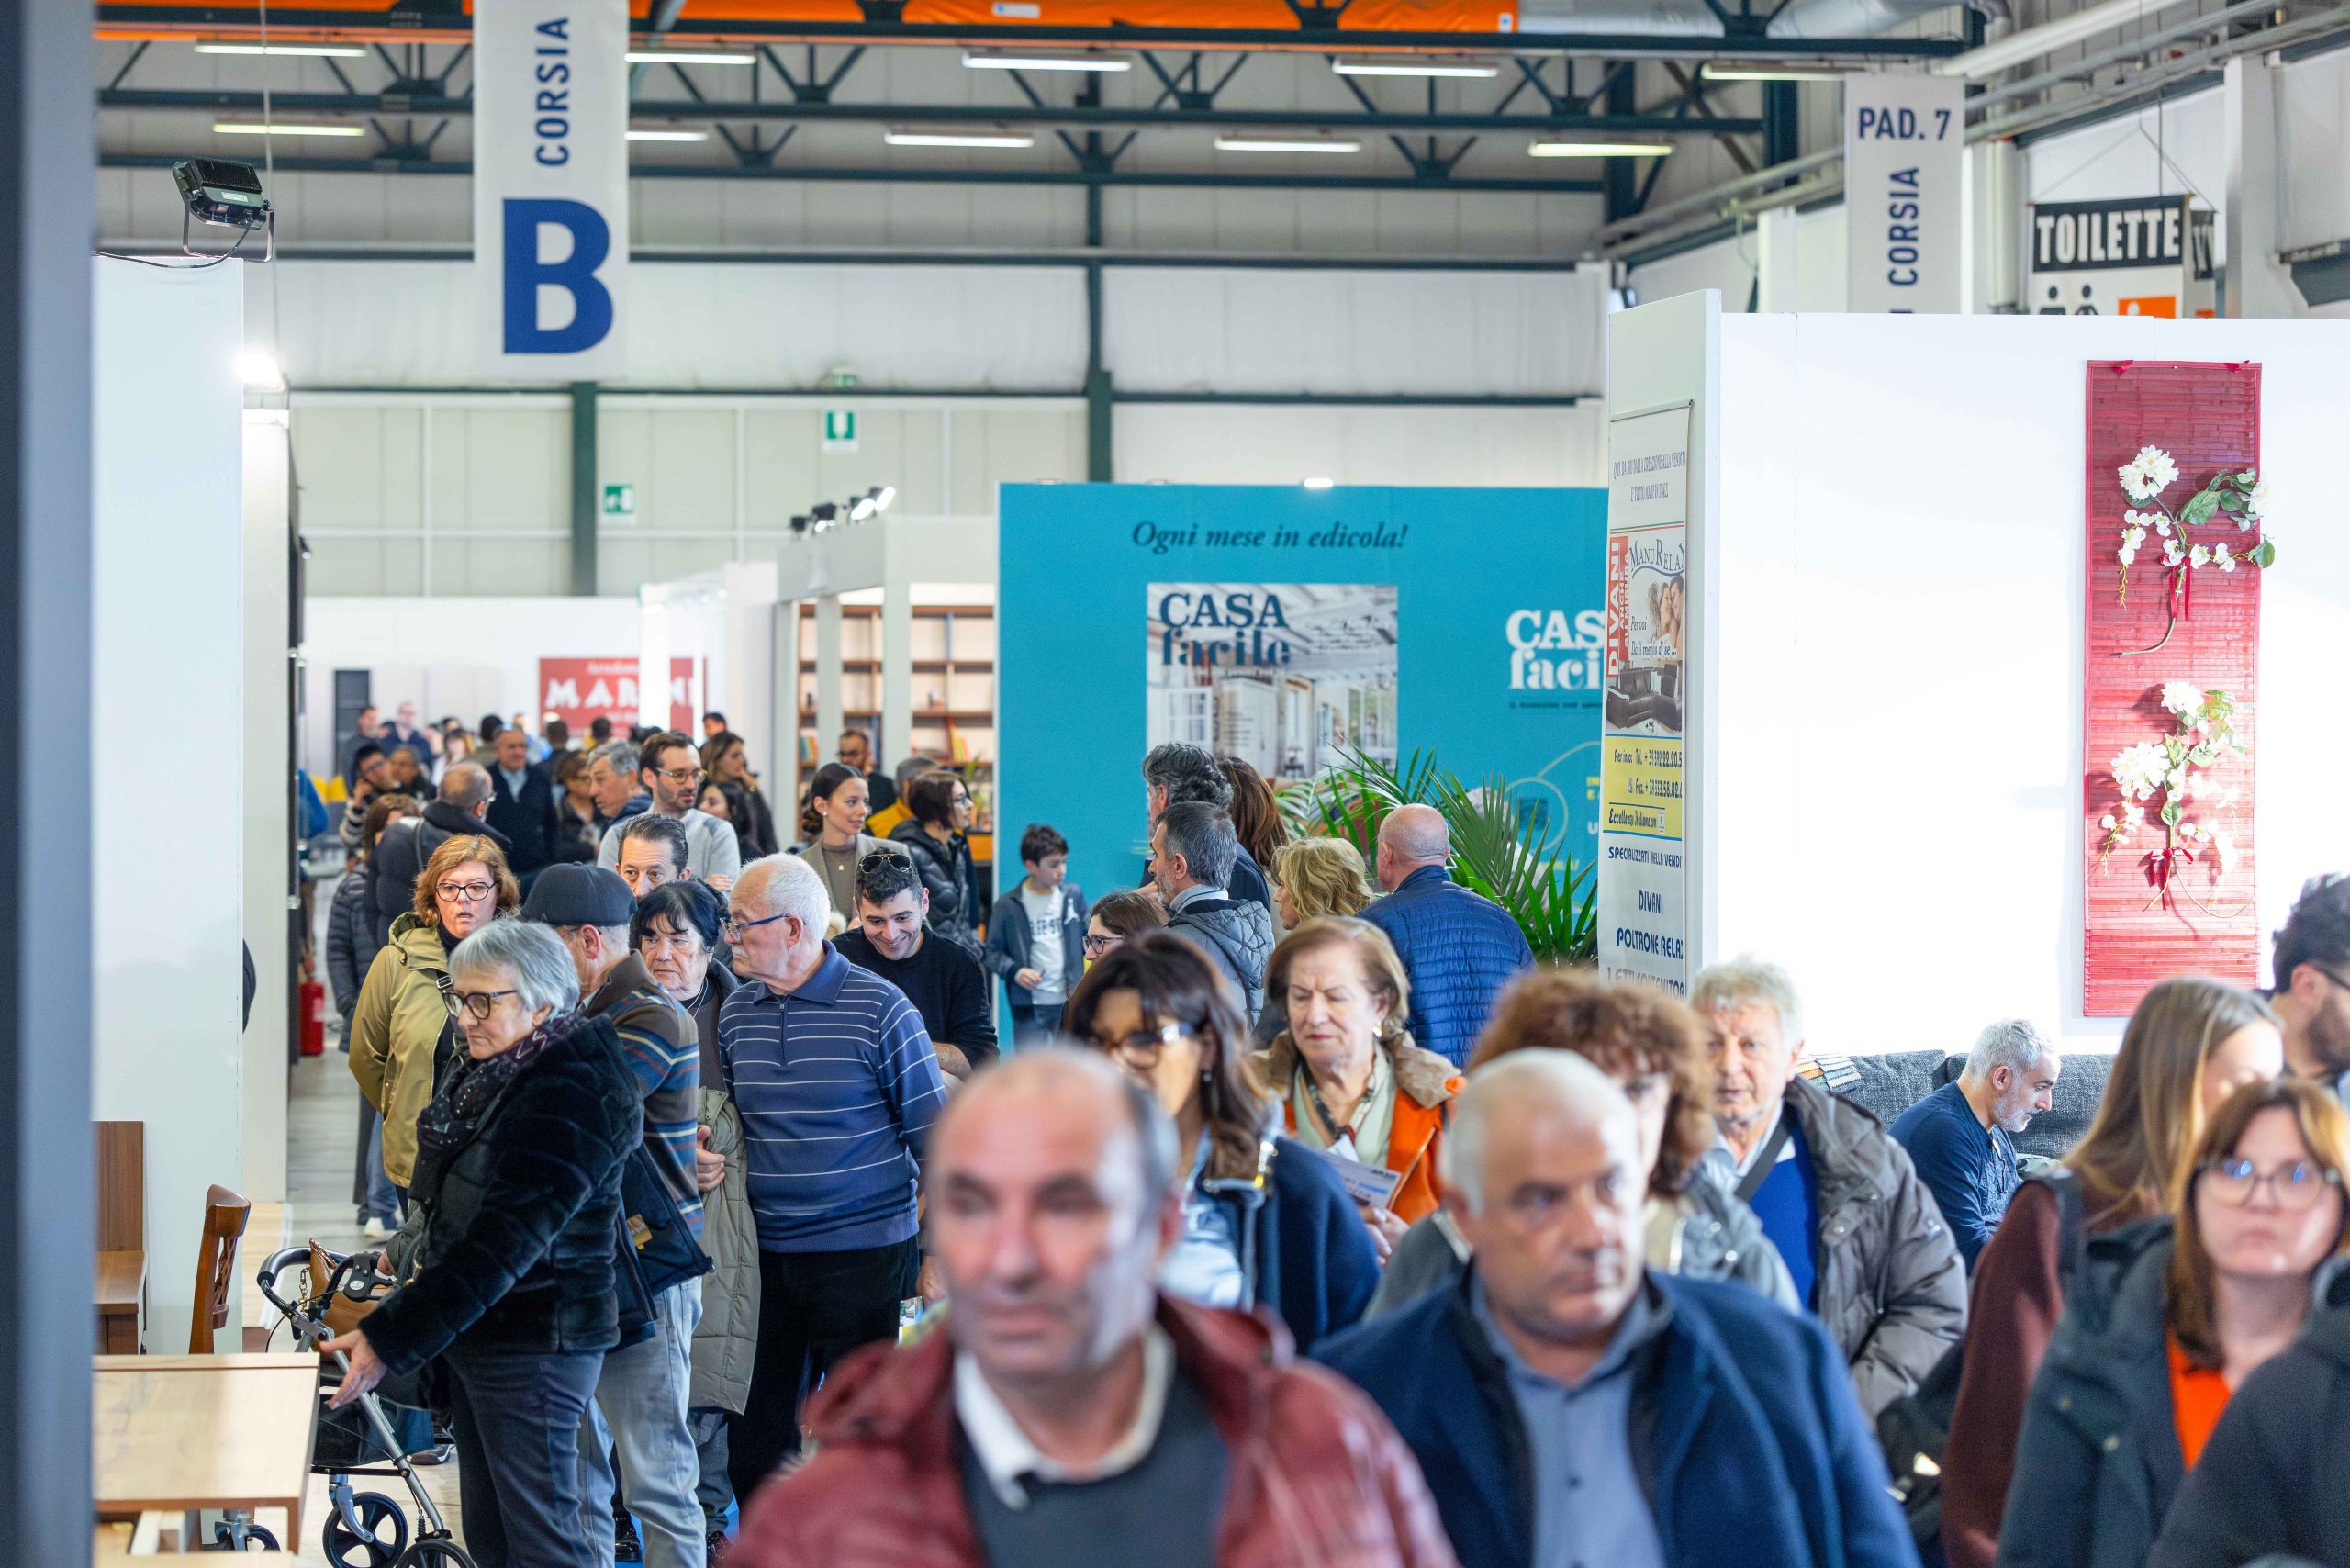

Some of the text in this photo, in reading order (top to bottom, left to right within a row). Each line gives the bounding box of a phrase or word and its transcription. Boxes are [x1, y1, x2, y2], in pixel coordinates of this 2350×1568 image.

[535, 17, 570, 166] CORSIA
[1858, 107, 1952, 140] PAD. 7
[1888, 166, 1920, 286] CORSIA
[2035, 208, 2182, 265] TOILETTE
[503, 197, 614, 354] B
[1132, 520, 1409, 554] Ogni mese in edicola!
[1159, 593, 1289, 628] CASA
[1608, 542, 1619, 675] DIVANI
[1630, 616, 1639, 631] Per
[1162, 628, 1292, 666] facile
[1505, 609, 1605, 650] CAS
[1509, 648, 1603, 690] faci
[1614, 749, 1623, 763] Per
[1608, 846, 1650, 864] SPECIALIZZATI
[1651, 851, 1664, 866] NELLA
[1639, 890, 1663, 915] DIVANI
[1616, 927, 1659, 956] POLTRONE
